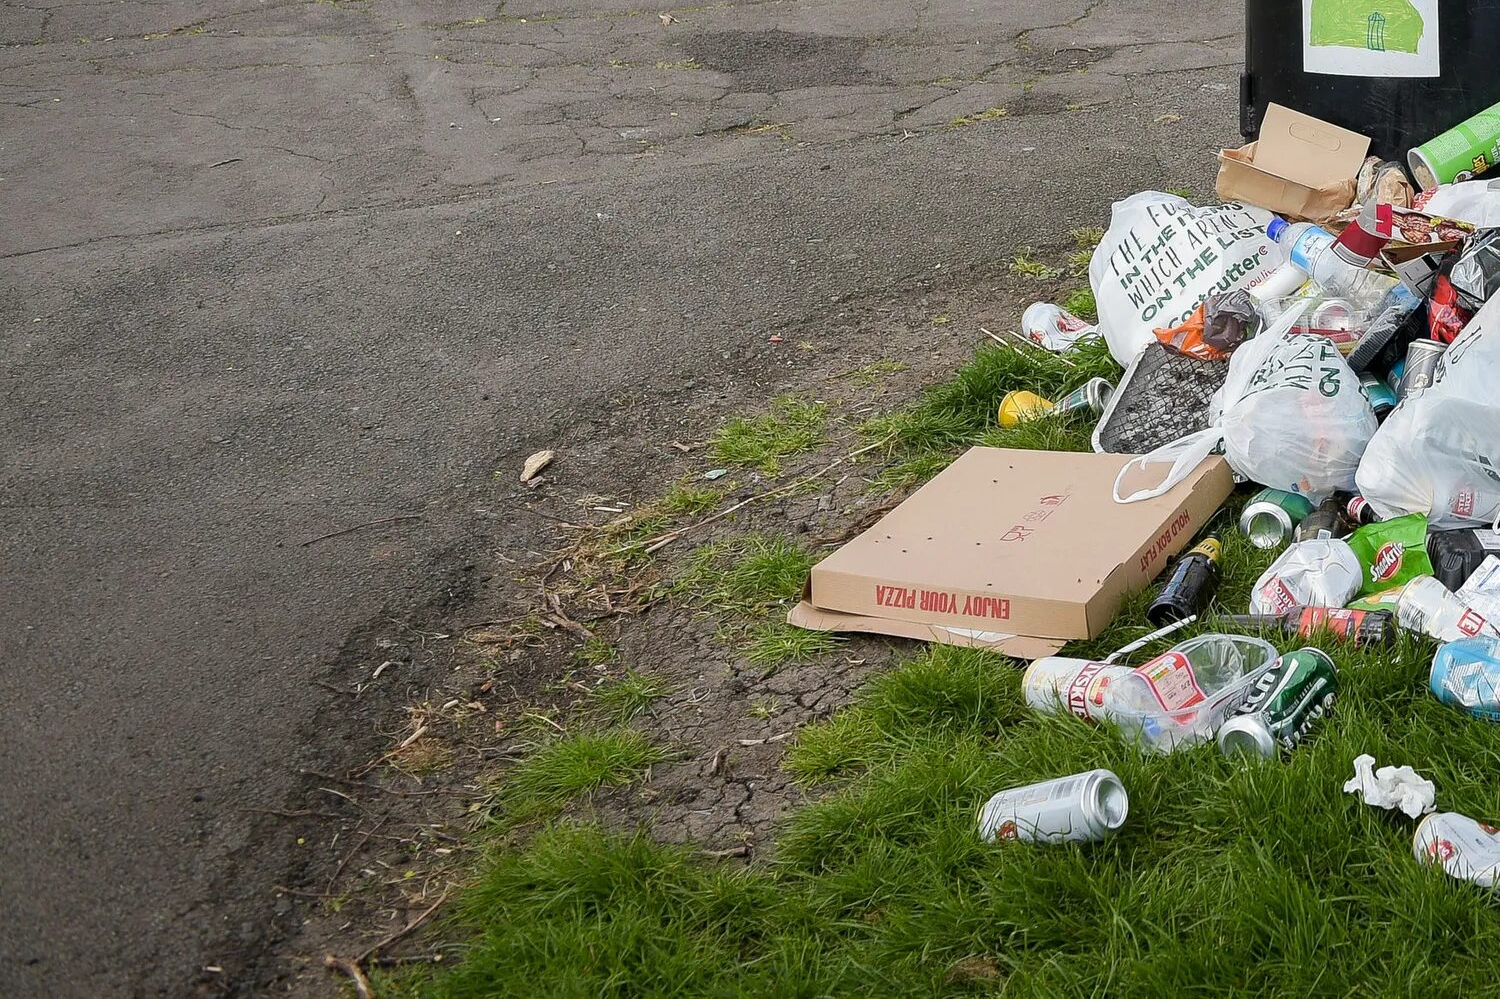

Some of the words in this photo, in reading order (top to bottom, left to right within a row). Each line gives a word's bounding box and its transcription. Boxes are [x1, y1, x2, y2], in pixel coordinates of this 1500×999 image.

[1108, 226, 1147, 277] THE
[1120, 265, 1141, 290] IN
[1141, 224, 1177, 265] THE
[1127, 246, 1183, 310] WHICH
[1186, 211, 1258, 250] AREN'T
[1141, 288, 1173, 322] ON
[1172, 245, 1219, 288] THE
[1216, 224, 1266, 251] LIST
[1319, 367, 1341, 397] ON
[1171, 508, 1191, 537] HOLD
[1156, 529, 1172, 553] BOX
[1140, 544, 1158, 572] FLAT
[1369, 542, 1406, 583] Snackrite
[876, 584, 917, 610] PIZZA
[919, 590, 958, 614] YOUR
[962, 595, 1010, 620] ENJOY
